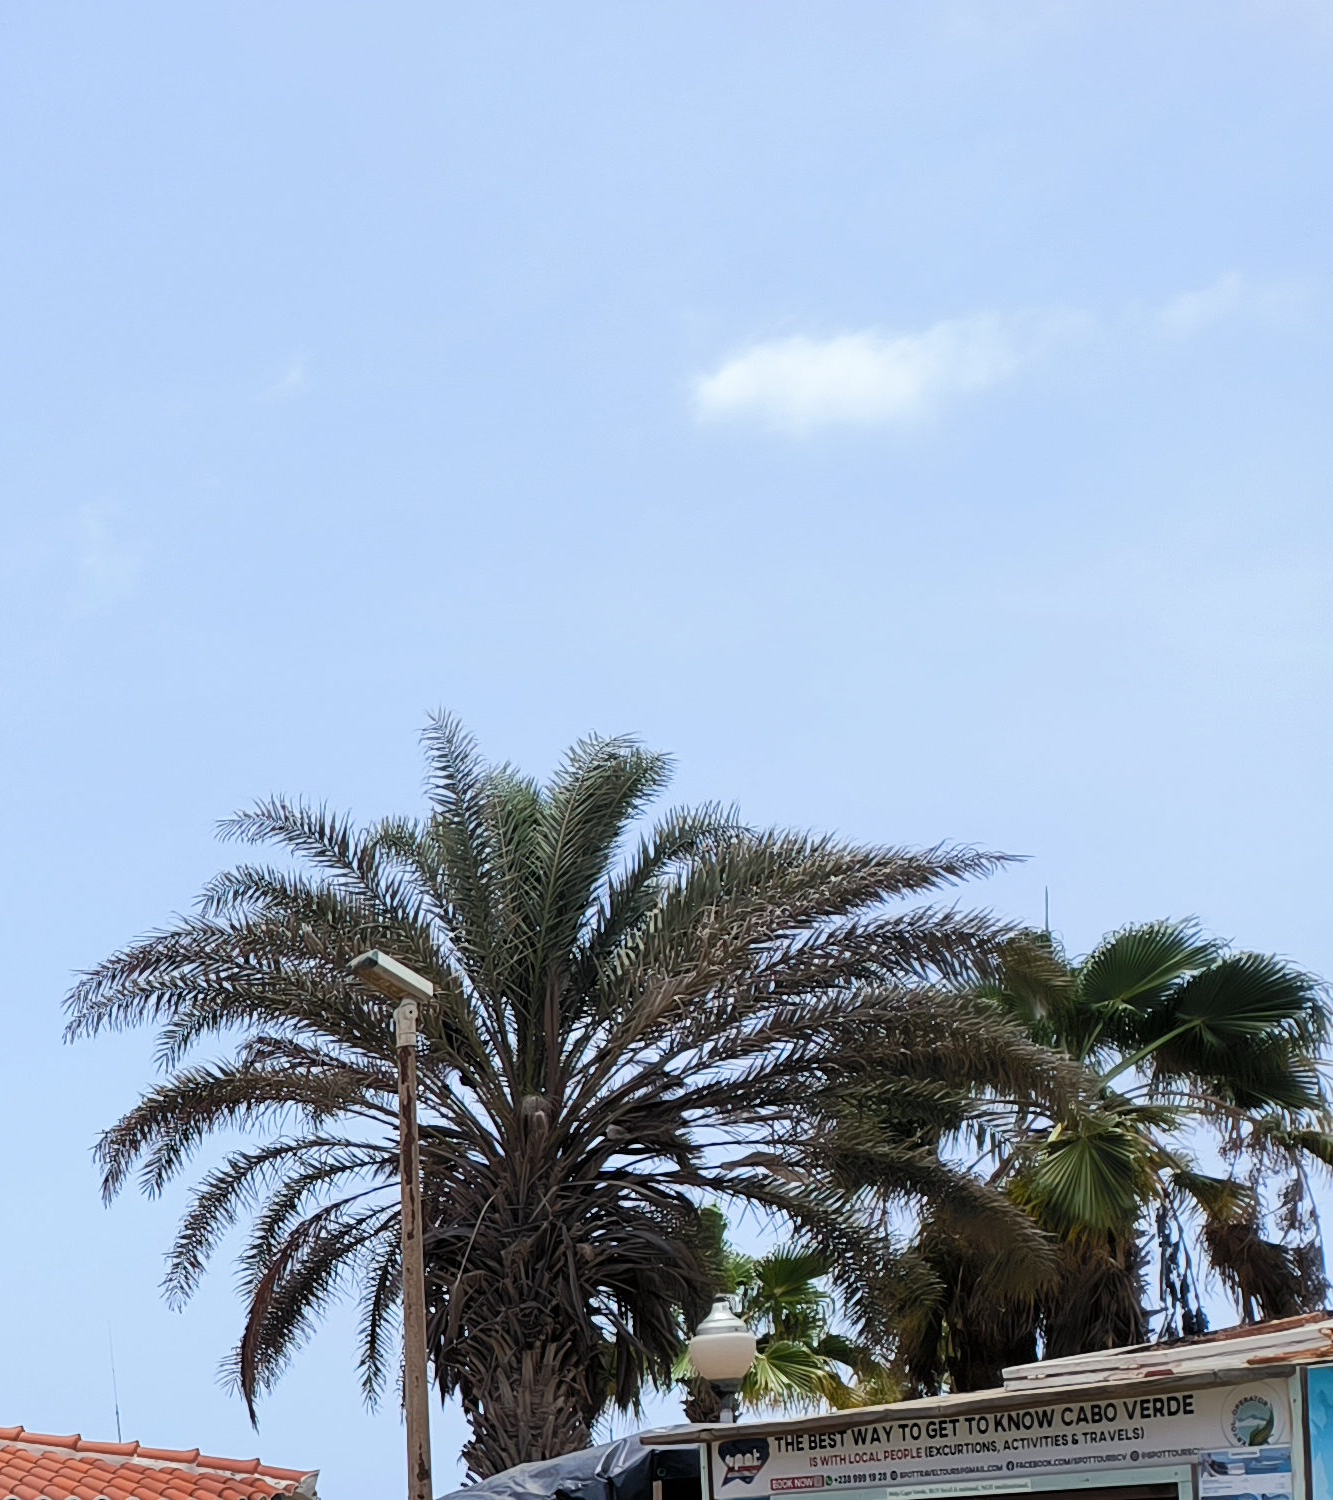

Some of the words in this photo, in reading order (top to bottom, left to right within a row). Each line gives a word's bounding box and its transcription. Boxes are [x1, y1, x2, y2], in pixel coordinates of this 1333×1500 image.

[774, 1434, 805, 1453] THE
[807, 1430, 847, 1451] BEST
[851, 1424, 894, 1446] WAY
[898, 1422, 922, 1443] TO
[925, 1418, 960, 1439] GET
[964, 1415, 989, 1436] TO
[993, 1408, 1056, 1433] KNOW
[1060, 1402, 1118, 1427] CABO
[1122, 1394, 1195, 1420] VERDE
[809, 1456, 819, 1468] IS
[820, 1453, 847, 1467] WITH
[848, 1450, 882, 1464] LOCAL
[883, 1446, 923, 1462] PEOPLE
[1003, 1433, 1069, 1453] ACTIVITIES
[1071, 1432, 1079, 1446] &
[1081, 1426, 1145, 1445] TRAVELS)
[771, 1478, 793, 1490] BOOK
[794, 1477, 814, 1489] NOW
[834, 1474, 852, 1485] +238
[869, 1472, 877, 1483] 19
